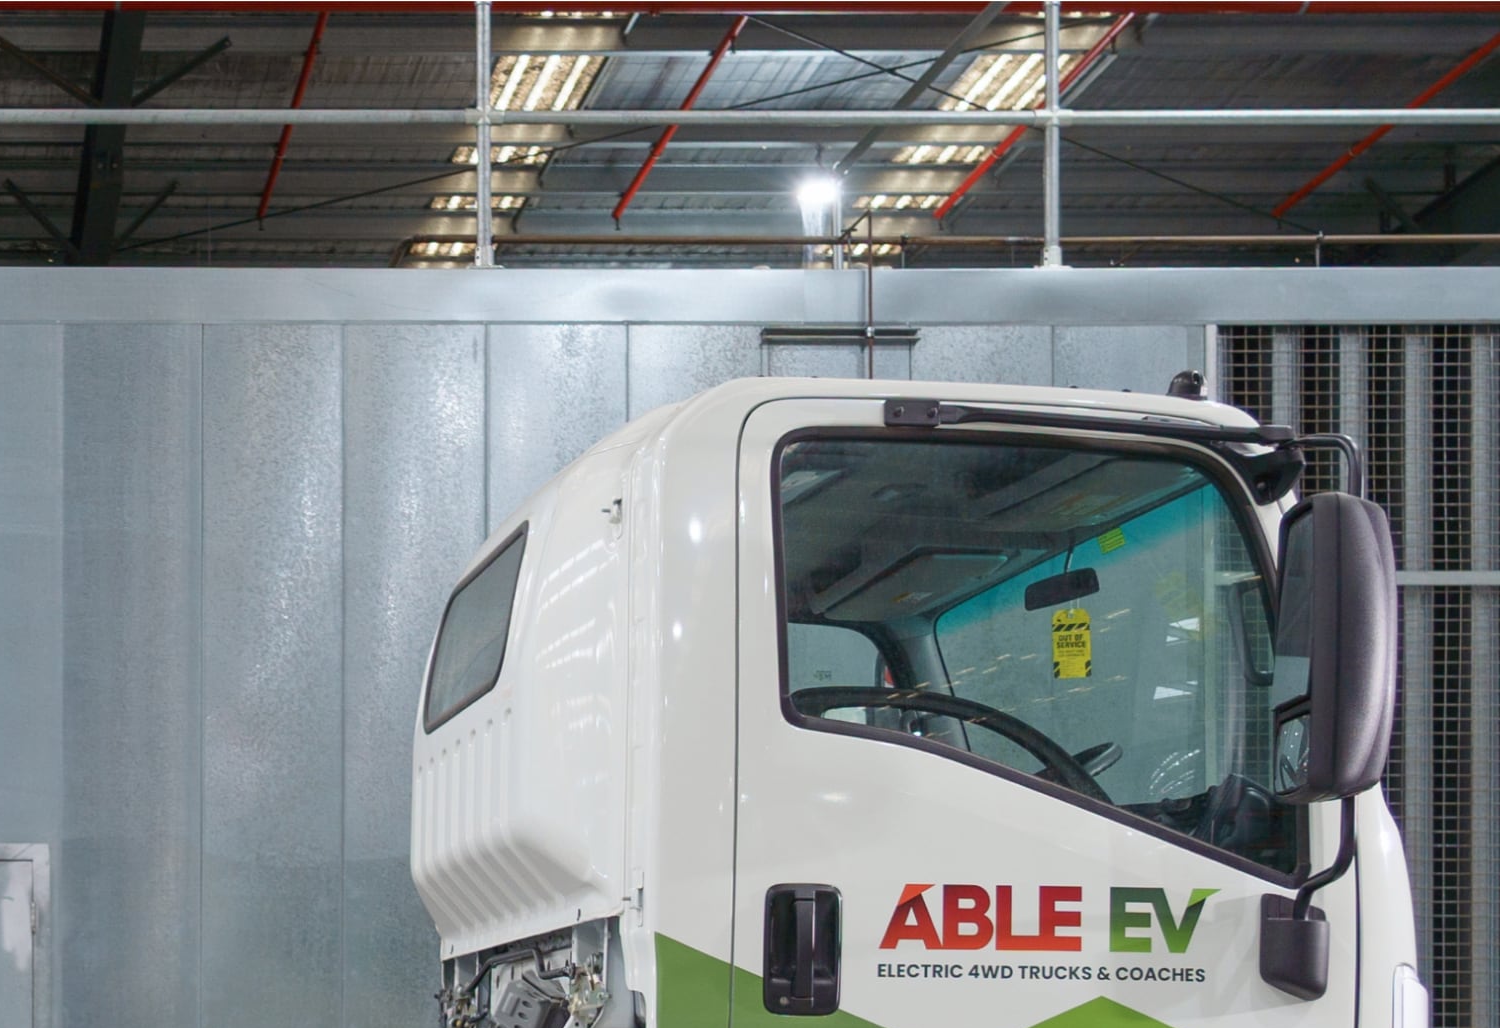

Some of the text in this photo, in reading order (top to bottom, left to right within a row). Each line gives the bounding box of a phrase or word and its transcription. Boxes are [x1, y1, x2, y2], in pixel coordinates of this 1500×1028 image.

[1056, 641, 1086, 649] SERVICE
[878, 883, 1222, 954] ABLE EV
[877, 963, 1206, 983] ELECTRIC 4WD TRUCKS & COACHES
